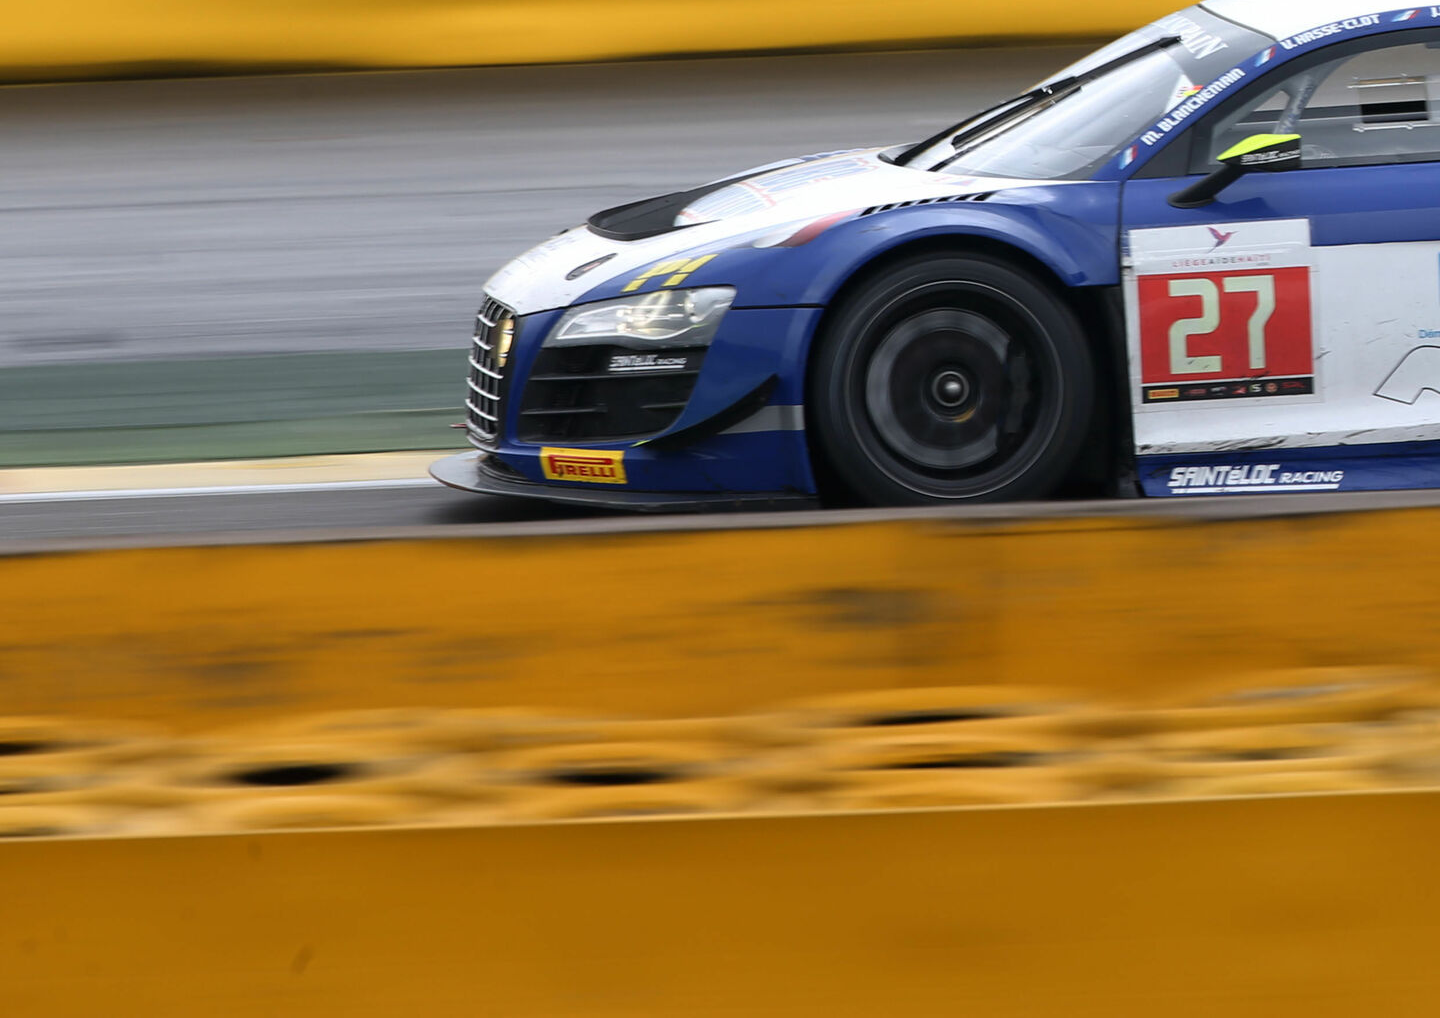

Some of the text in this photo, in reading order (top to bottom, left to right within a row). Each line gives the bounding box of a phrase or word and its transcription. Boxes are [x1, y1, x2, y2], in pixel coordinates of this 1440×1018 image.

[1156, 68, 1246, 132] BLANCHEMAIN
[1168, 275, 1276, 375] 27
[548, 455, 616, 478] PIRELLI
[1279, 471, 1344, 484] RACING
